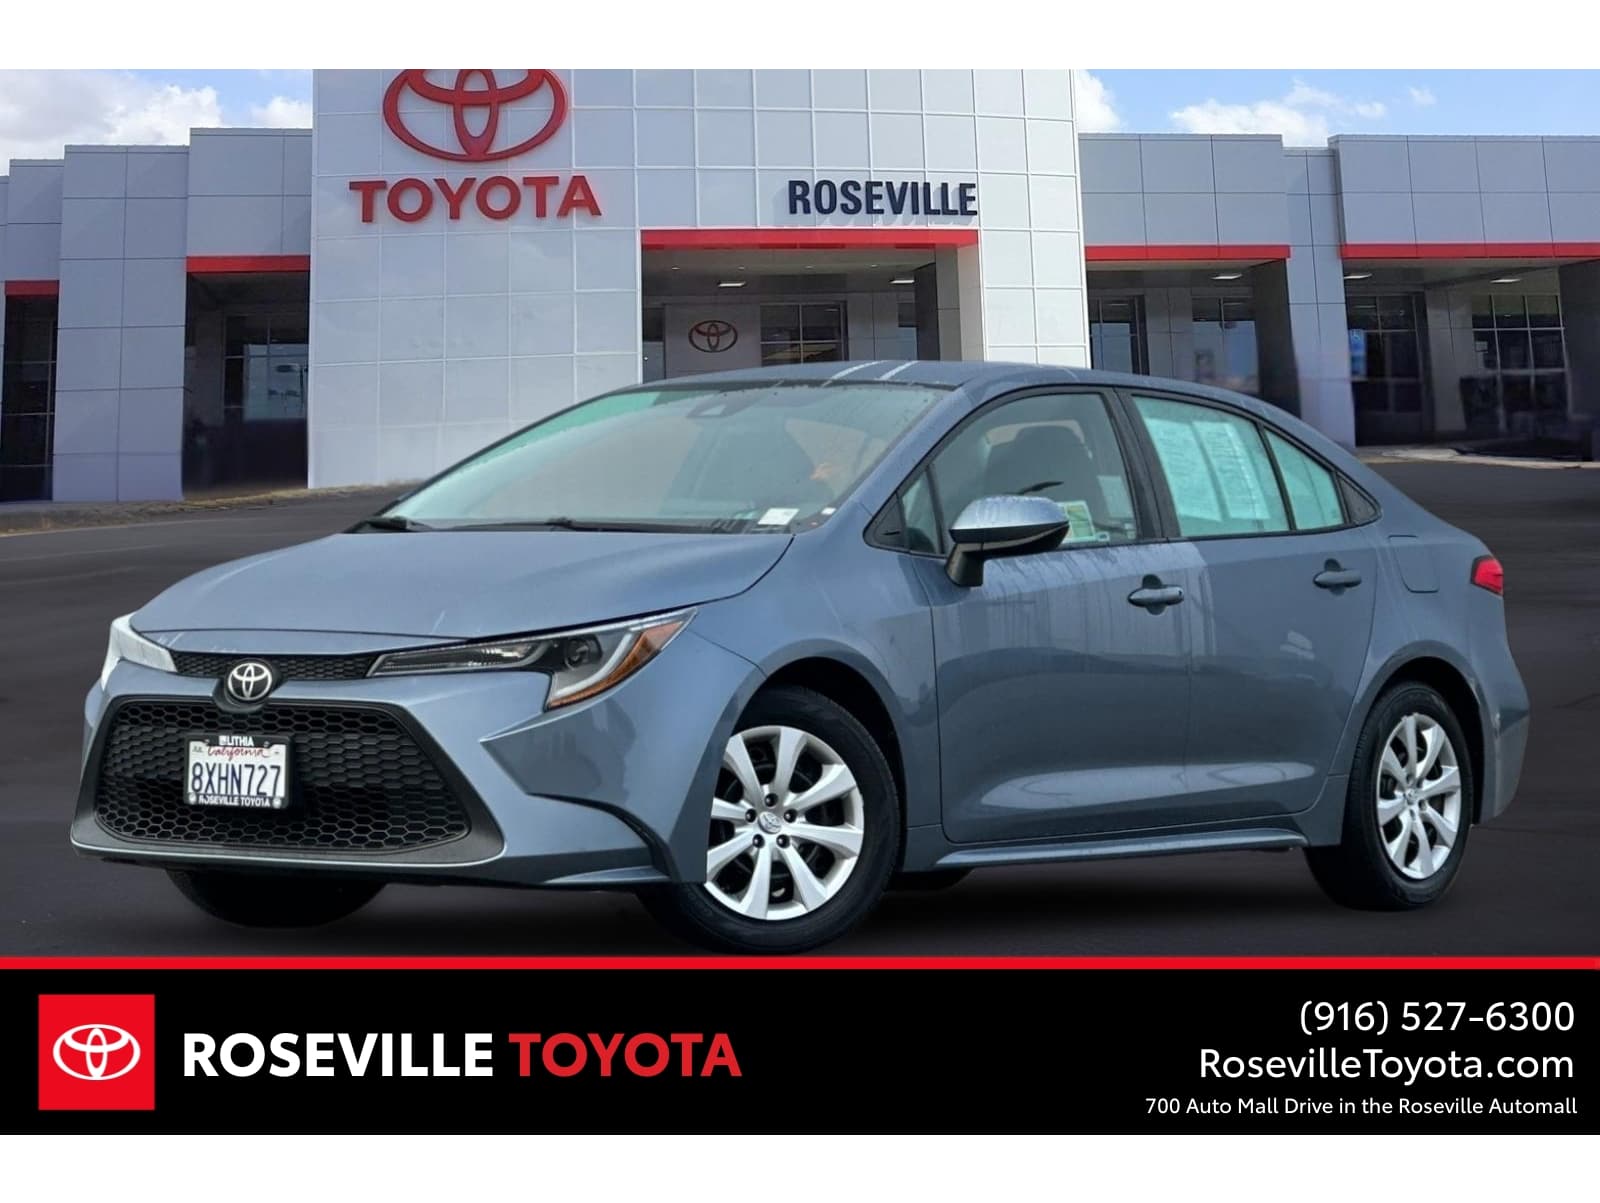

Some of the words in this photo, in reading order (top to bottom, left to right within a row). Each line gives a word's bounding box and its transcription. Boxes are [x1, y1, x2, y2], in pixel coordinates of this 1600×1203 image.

[349, 175, 602, 224] TOYOTA
[788, 179, 978, 217] ROSEVILLE
[207, 746, 270, 761] California
[227, 735, 254, 747] LITHIA
[191, 762, 281, 797] 8XHN727
[198, 795, 239, 806] ROSEVILLE
[240, 796, 271, 808] TOYOTA
